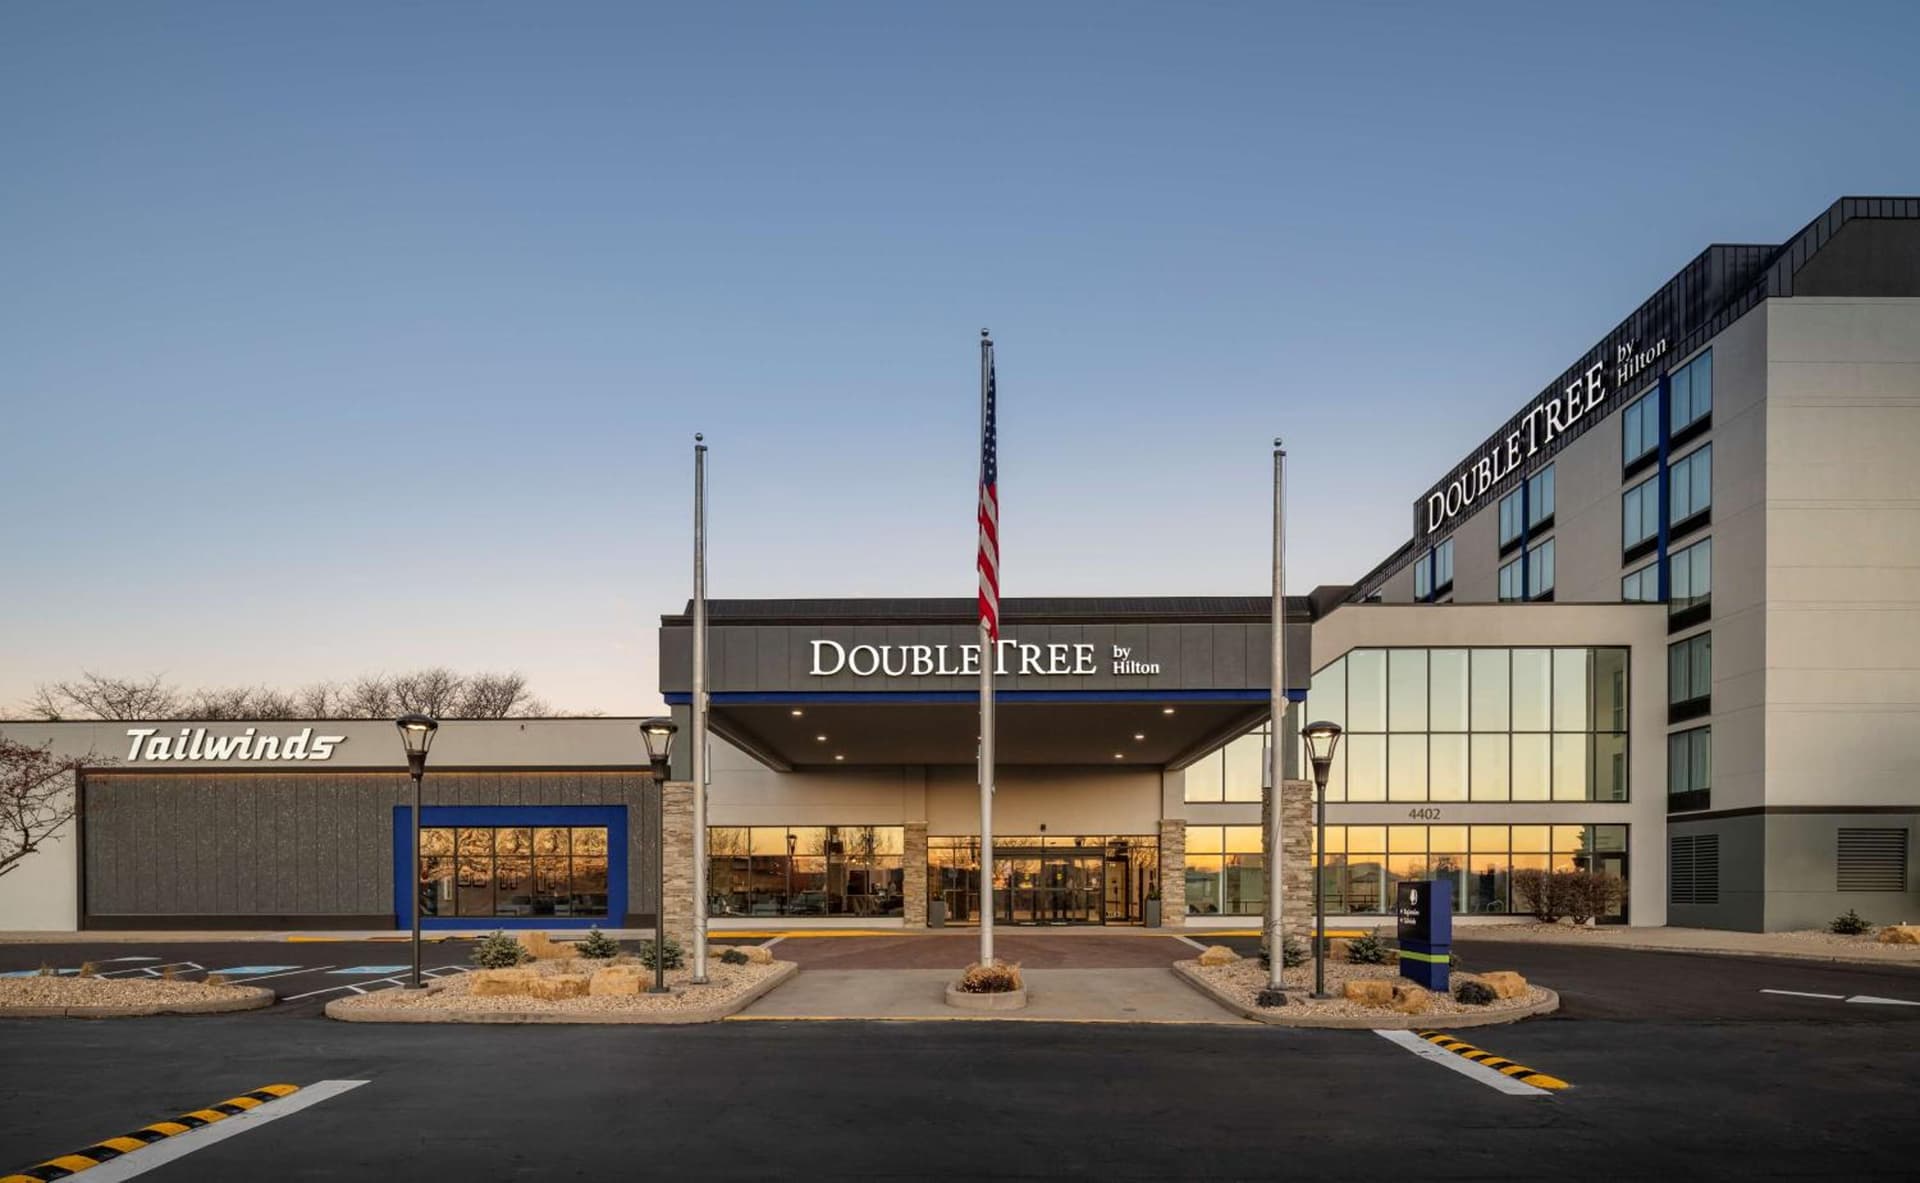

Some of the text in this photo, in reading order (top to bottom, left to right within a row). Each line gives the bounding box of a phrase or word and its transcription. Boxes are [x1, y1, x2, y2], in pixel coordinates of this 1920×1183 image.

[1617, 339, 1634, 363] by
[1617, 340, 1667, 387] Hilton
[1112, 645, 1131, 660] by
[1112, 661, 1160, 675] Hilton
[126, 727, 346, 761] Tailwinds
[1408, 808, 1441, 820] 4402
